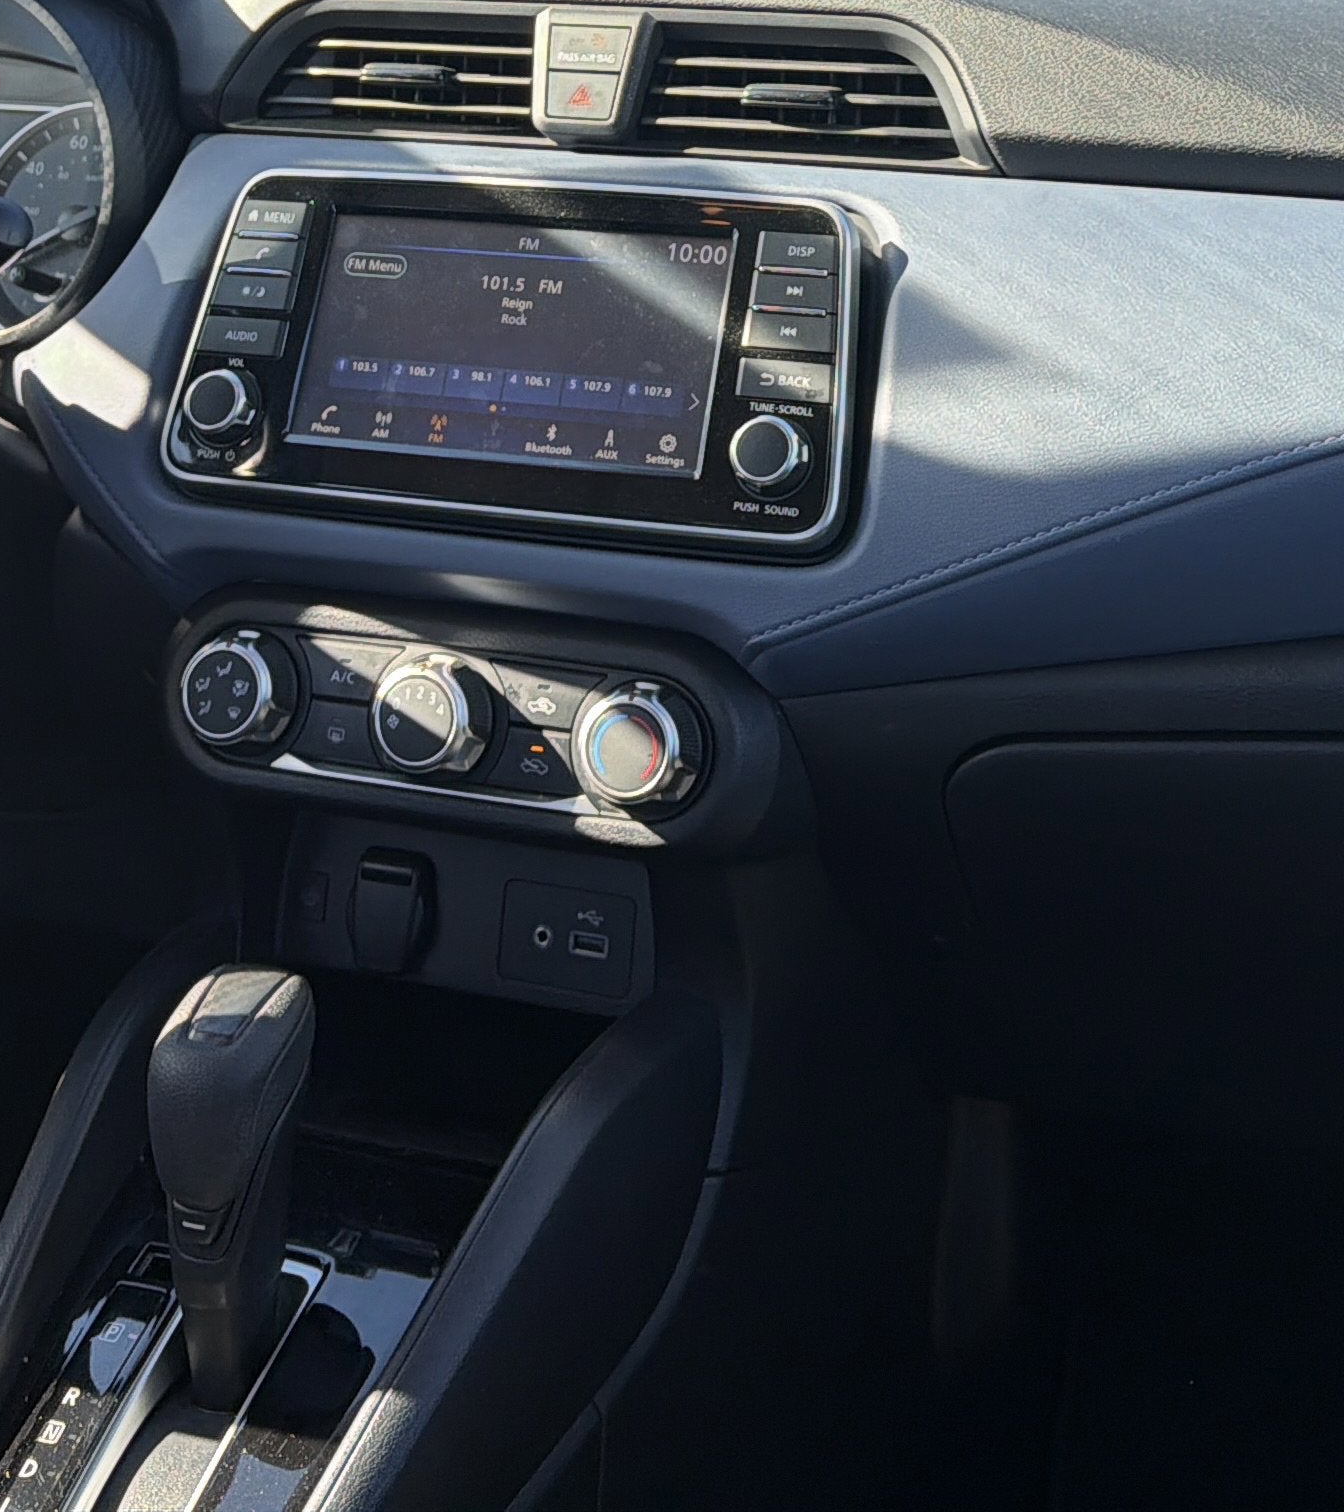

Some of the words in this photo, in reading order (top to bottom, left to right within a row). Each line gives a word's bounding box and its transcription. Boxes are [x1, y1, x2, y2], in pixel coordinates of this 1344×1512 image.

[69, 135, 89, 150] 60
[263, 211, 296, 224] MENU
[518, 237, 540, 251] FM
[787, 245, 816, 258] DISP
[667, 242, 728, 265] 10:00
[347, 257, 366, 270] FM
[368, 258, 402, 273] Menu
[481, 275, 525, 292] 101.5
[538, 279, 564, 295] FM
[501, 296, 533, 311] Reign
[500, 313, 528, 326] Rock
[224, 330, 258, 342] AUDIO
[228, 357, 245, 367] VOL
[409, 365, 435, 377] 106.7
[471, 371, 492, 382] 98.1
[583, 380, 611, 393] 107.9
[643, 385, 672, 398] 107.9
[777, 374, 812, 388] BACK
[310, 422, 341, 434] Phone
[371, 428, 390, 439] AM
[427, 433, 444, 443] FM
[196, 448, 221, 460] PUSH
[525, 441, 572, 456] Bluetooth
[595, 449, 618, 460] AUX
[645, 453, 685, 469] Settings
[733, 501, 760, 513] PUSH
[764, 504, 800, 517] SOUND
[330, 670, 356, 685] A/C
[416, 685, 425, 700] 2
[428, 691, 437, 705] 3
[436, 703, 445, 716] 4
[61, 1386, 81, 1407] R
[18, 1457, 39, 1478] D
